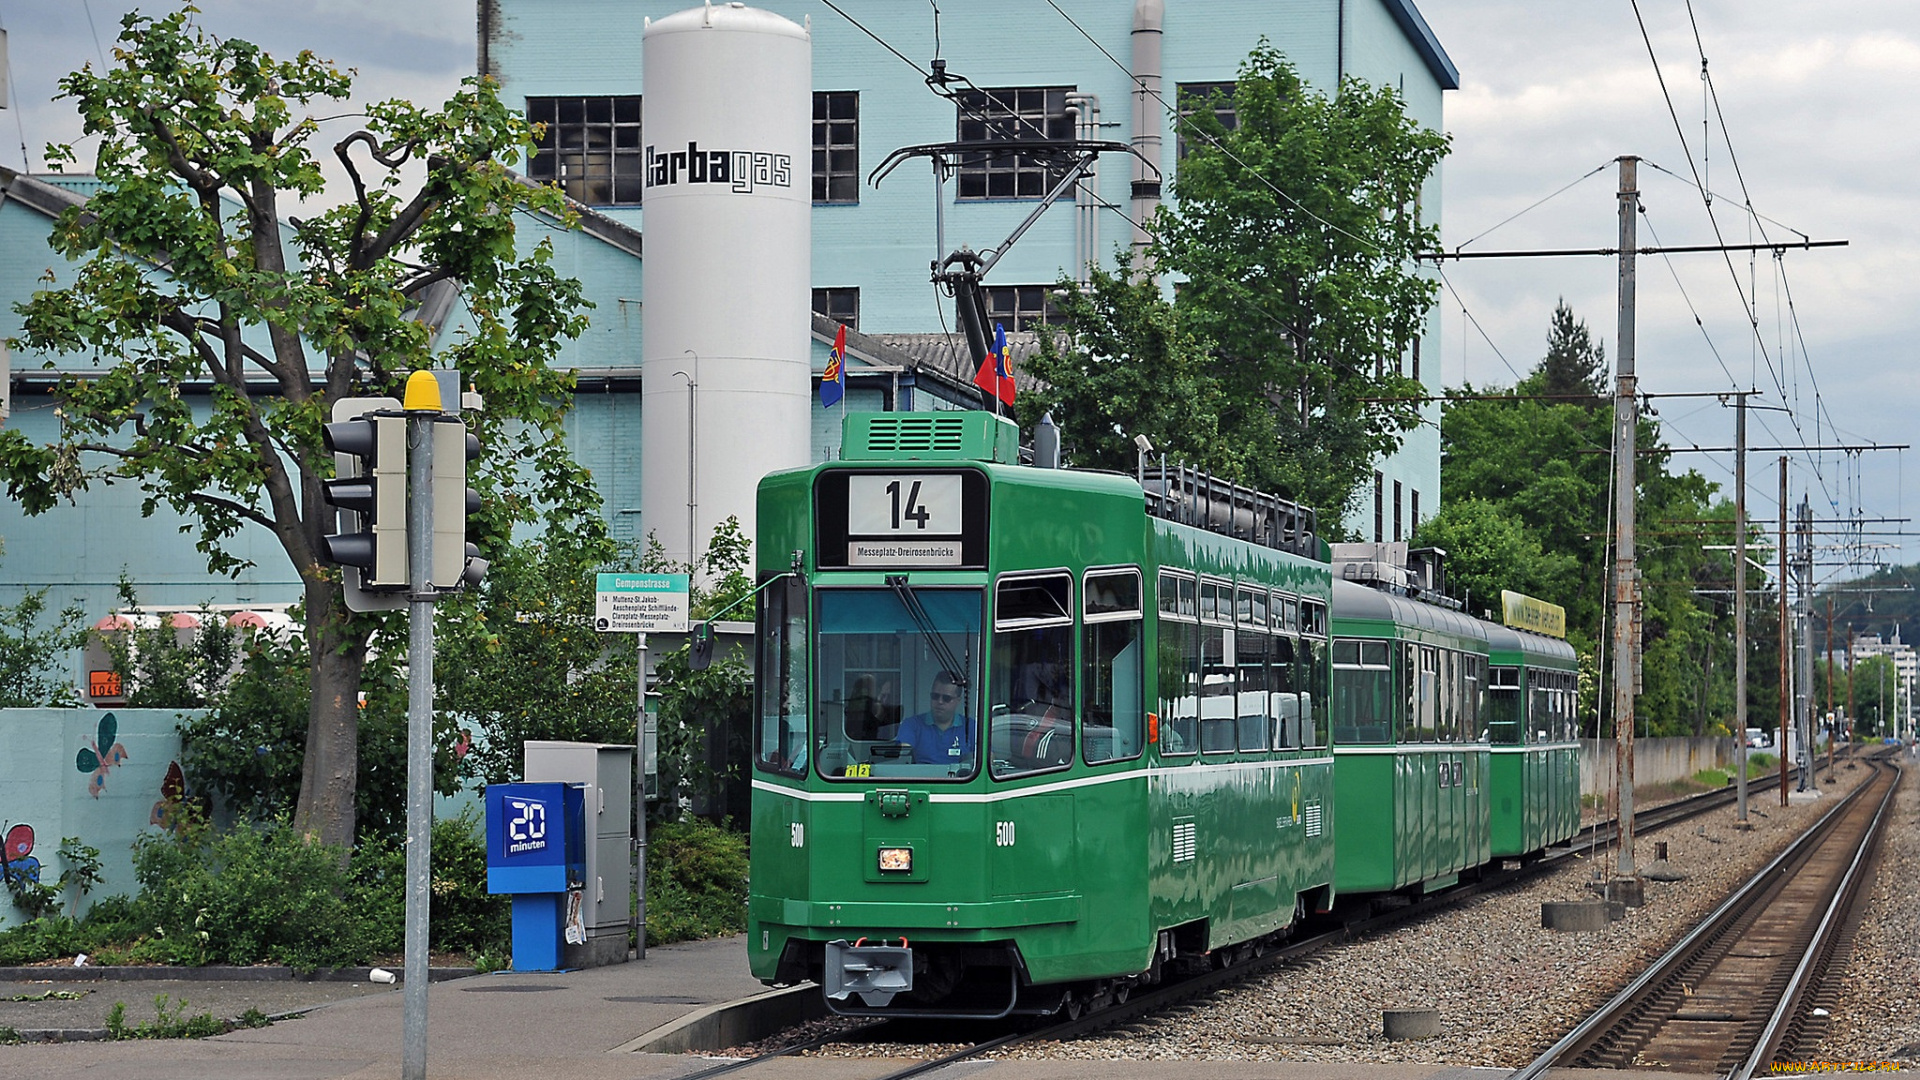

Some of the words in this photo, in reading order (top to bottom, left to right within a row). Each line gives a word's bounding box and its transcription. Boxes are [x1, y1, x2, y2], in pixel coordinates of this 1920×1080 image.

[646, 141, 791, 194] Carbagas
[886, 480, 930, 529] 14
[857, 546, 954, 558] Messeplatz-Dreirosenbrücke
[615, 578, 670, 589] Gempenstrasse
[612, 604, 647, 612] Aeschenplatz
[612, 620, 655, 628] Dreirosenbrücke
[92, 685, 120, 695] 1049
[510, 801, 545, 840] 20
[791, 822, 804, 847] 500
[996, 821, 1015, 846] 500
[510, 840, 546, 853] minuten
